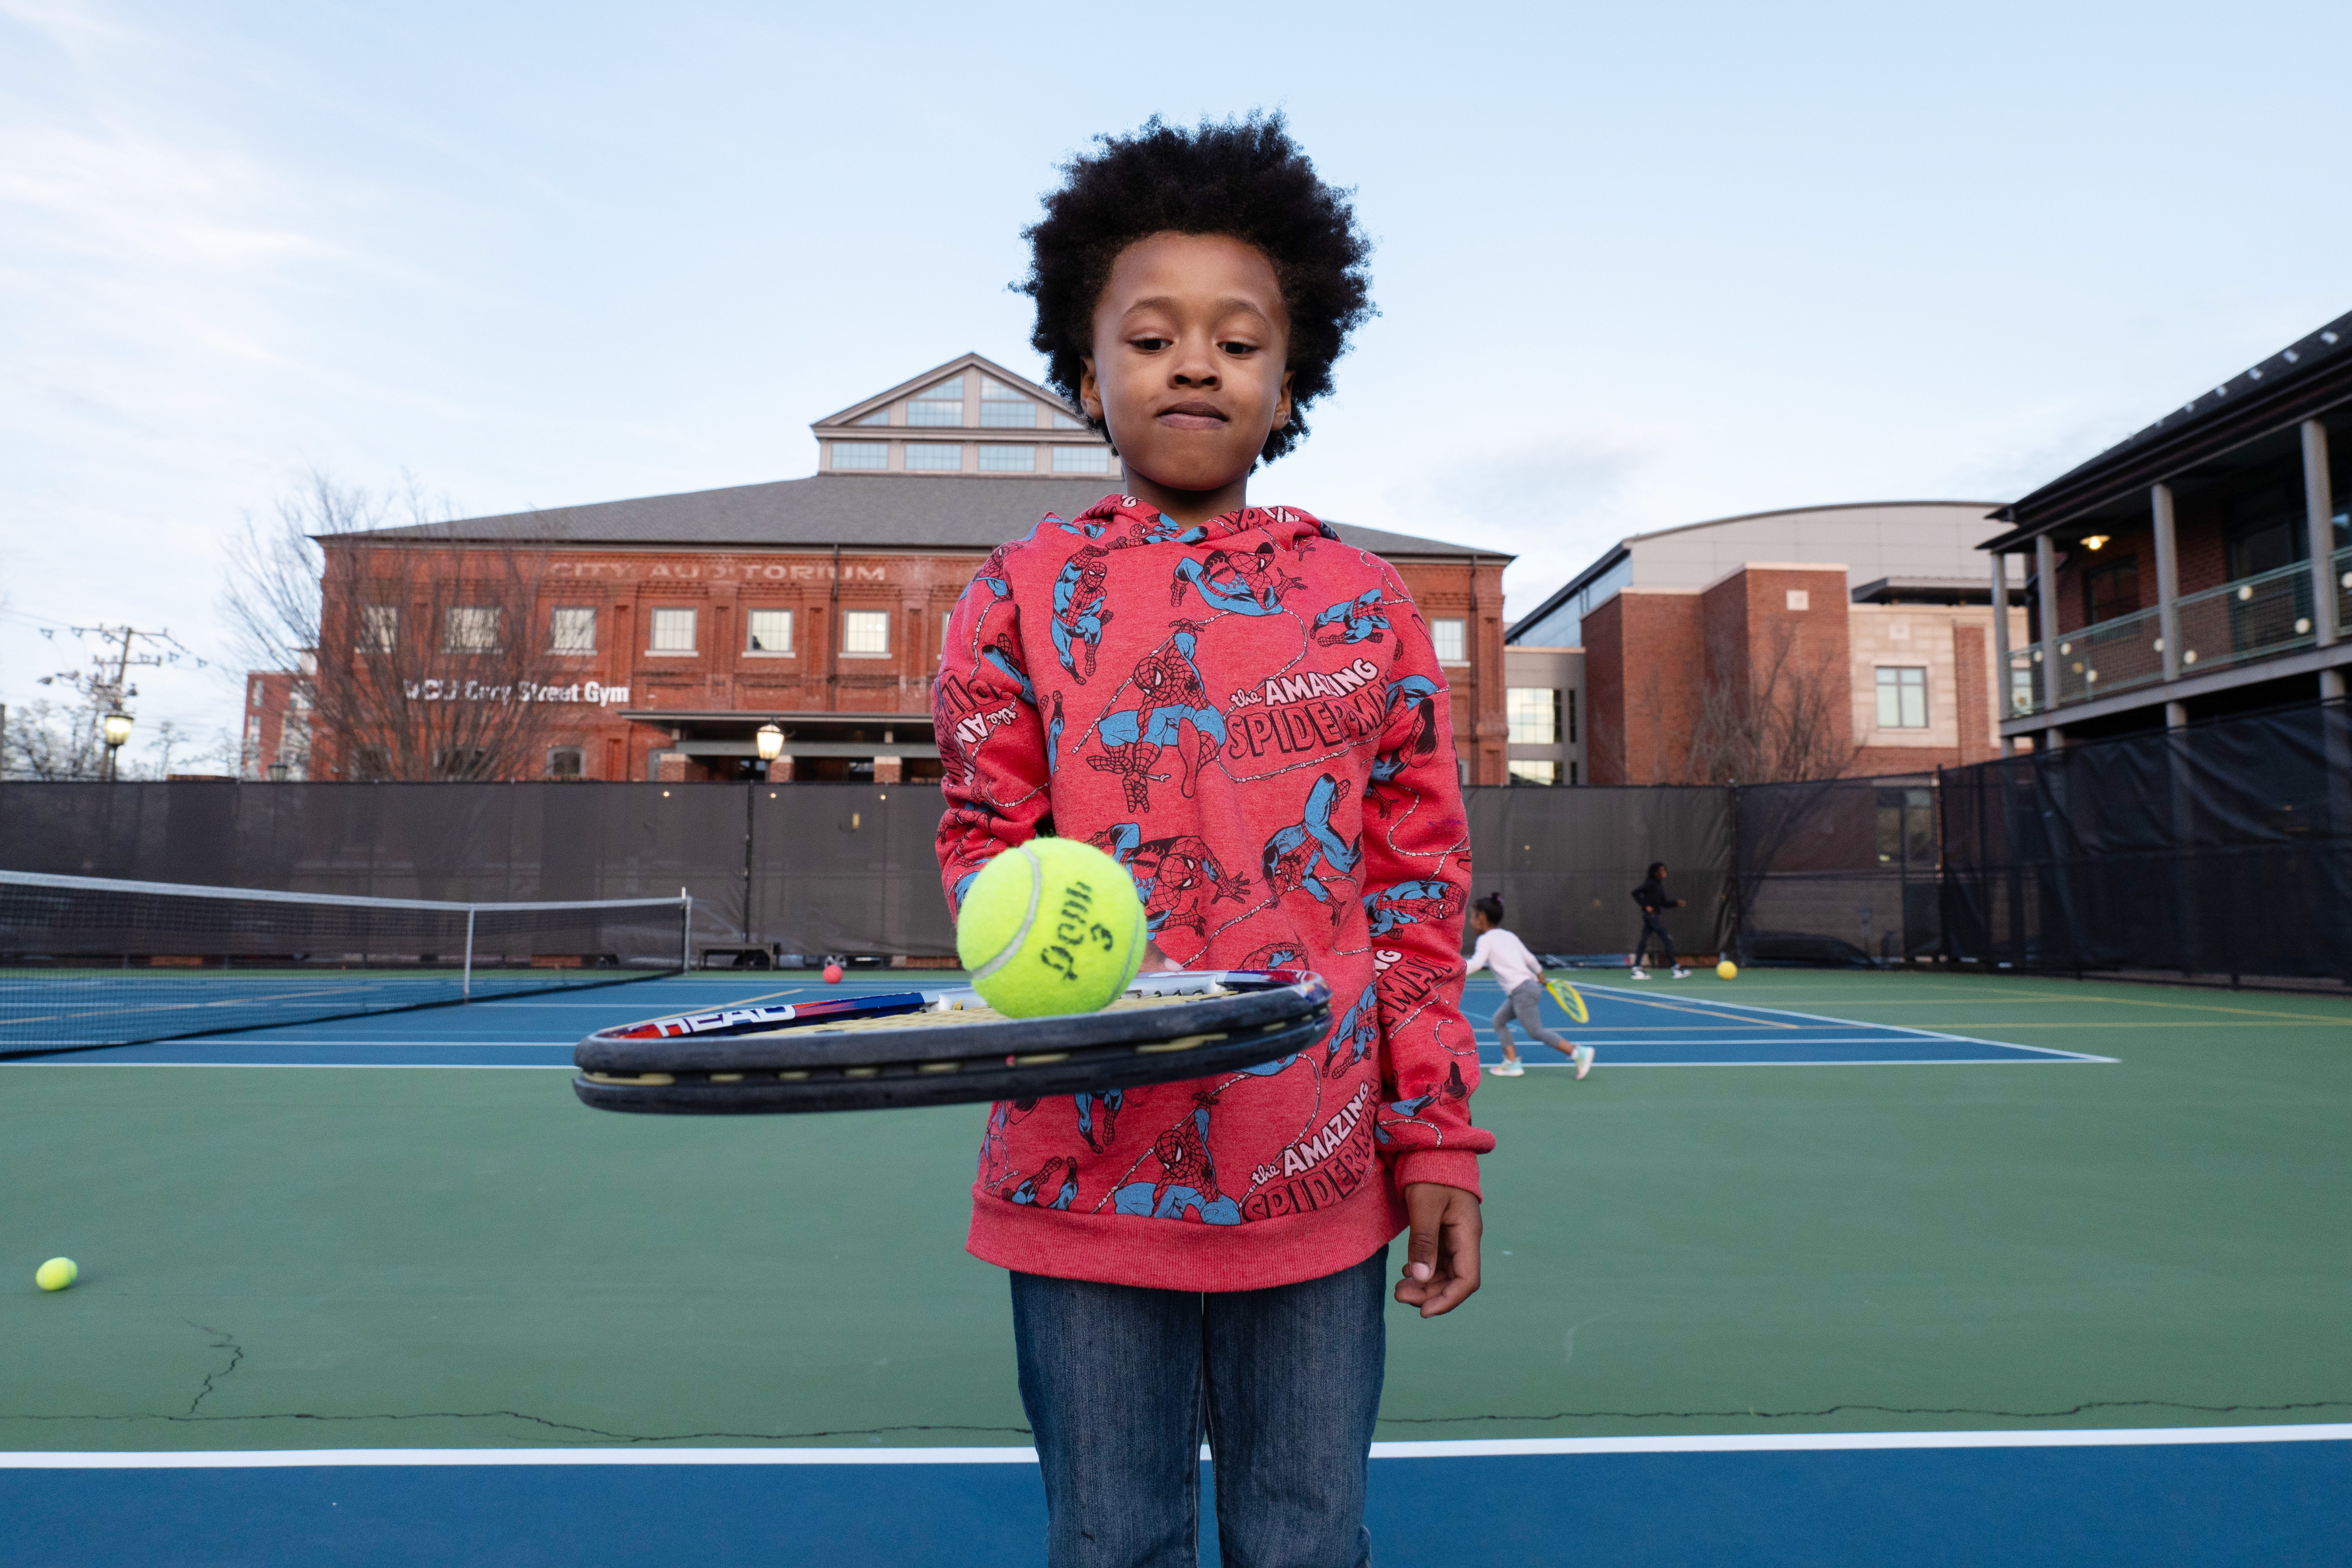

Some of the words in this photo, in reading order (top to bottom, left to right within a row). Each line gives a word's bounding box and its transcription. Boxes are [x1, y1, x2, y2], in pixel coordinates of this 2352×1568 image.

[550, 563, 633, 577] CITY
[518, 680, 579, 702] Street
[584, 681, 629, 707] Gym
[1230, 688, 1263, 708] the
[1265, 658, 1379, 706] AMAZING
[985, 707, 1018, 726] the
[1090, 922, 1114, 952] 3
[1250, 1164, 1281, 1186] the
[1283, 1080, 1368, 1179] AMAZING
